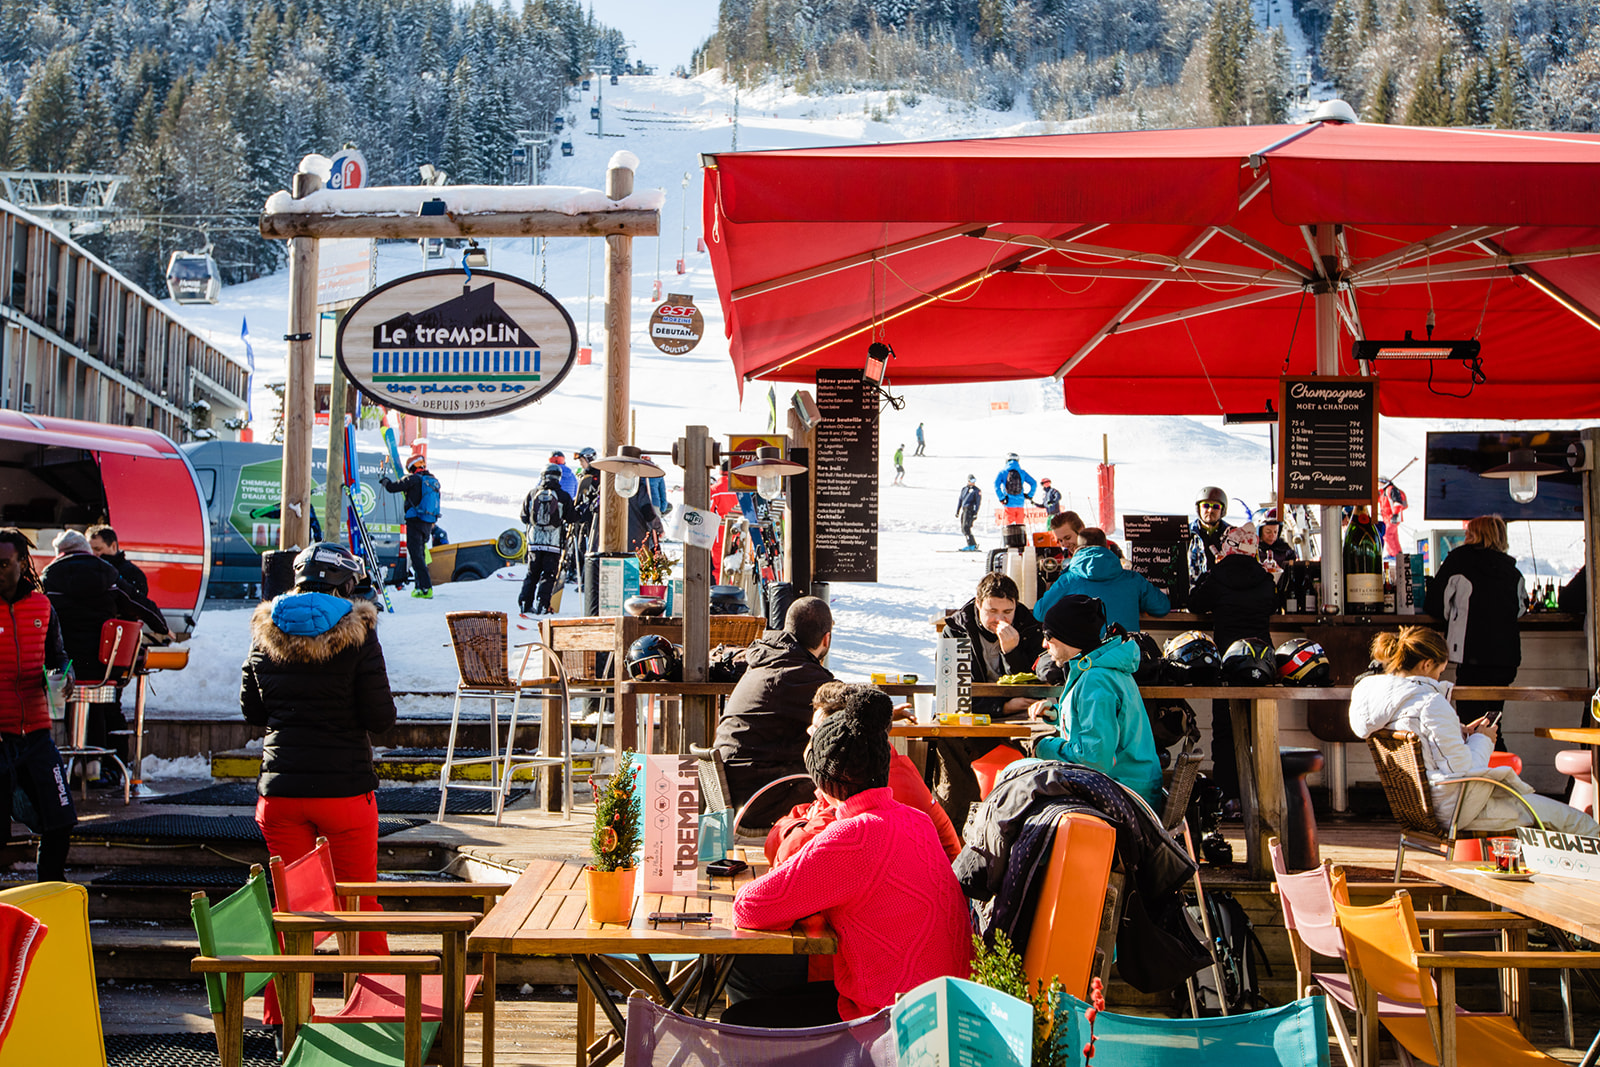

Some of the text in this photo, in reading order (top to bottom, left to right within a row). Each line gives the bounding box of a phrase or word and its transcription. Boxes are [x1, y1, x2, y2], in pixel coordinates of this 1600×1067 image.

[659, 305, 696, 316] esf
[659, 343, 689, 353] ADULTES
[387, 383, 525, 395] the place to be
[1291, 383, 1366, 404] Champagnes
[422, 400, 486, 410] DEPUIS 1936
[1323, 403, 1359, 411] CHANDON
[1289, 471, 1311, 481] Dom
[242, 479, 281, 488] CHEMISAGE
[1517, 827, 1600, 856] EMPLIN
